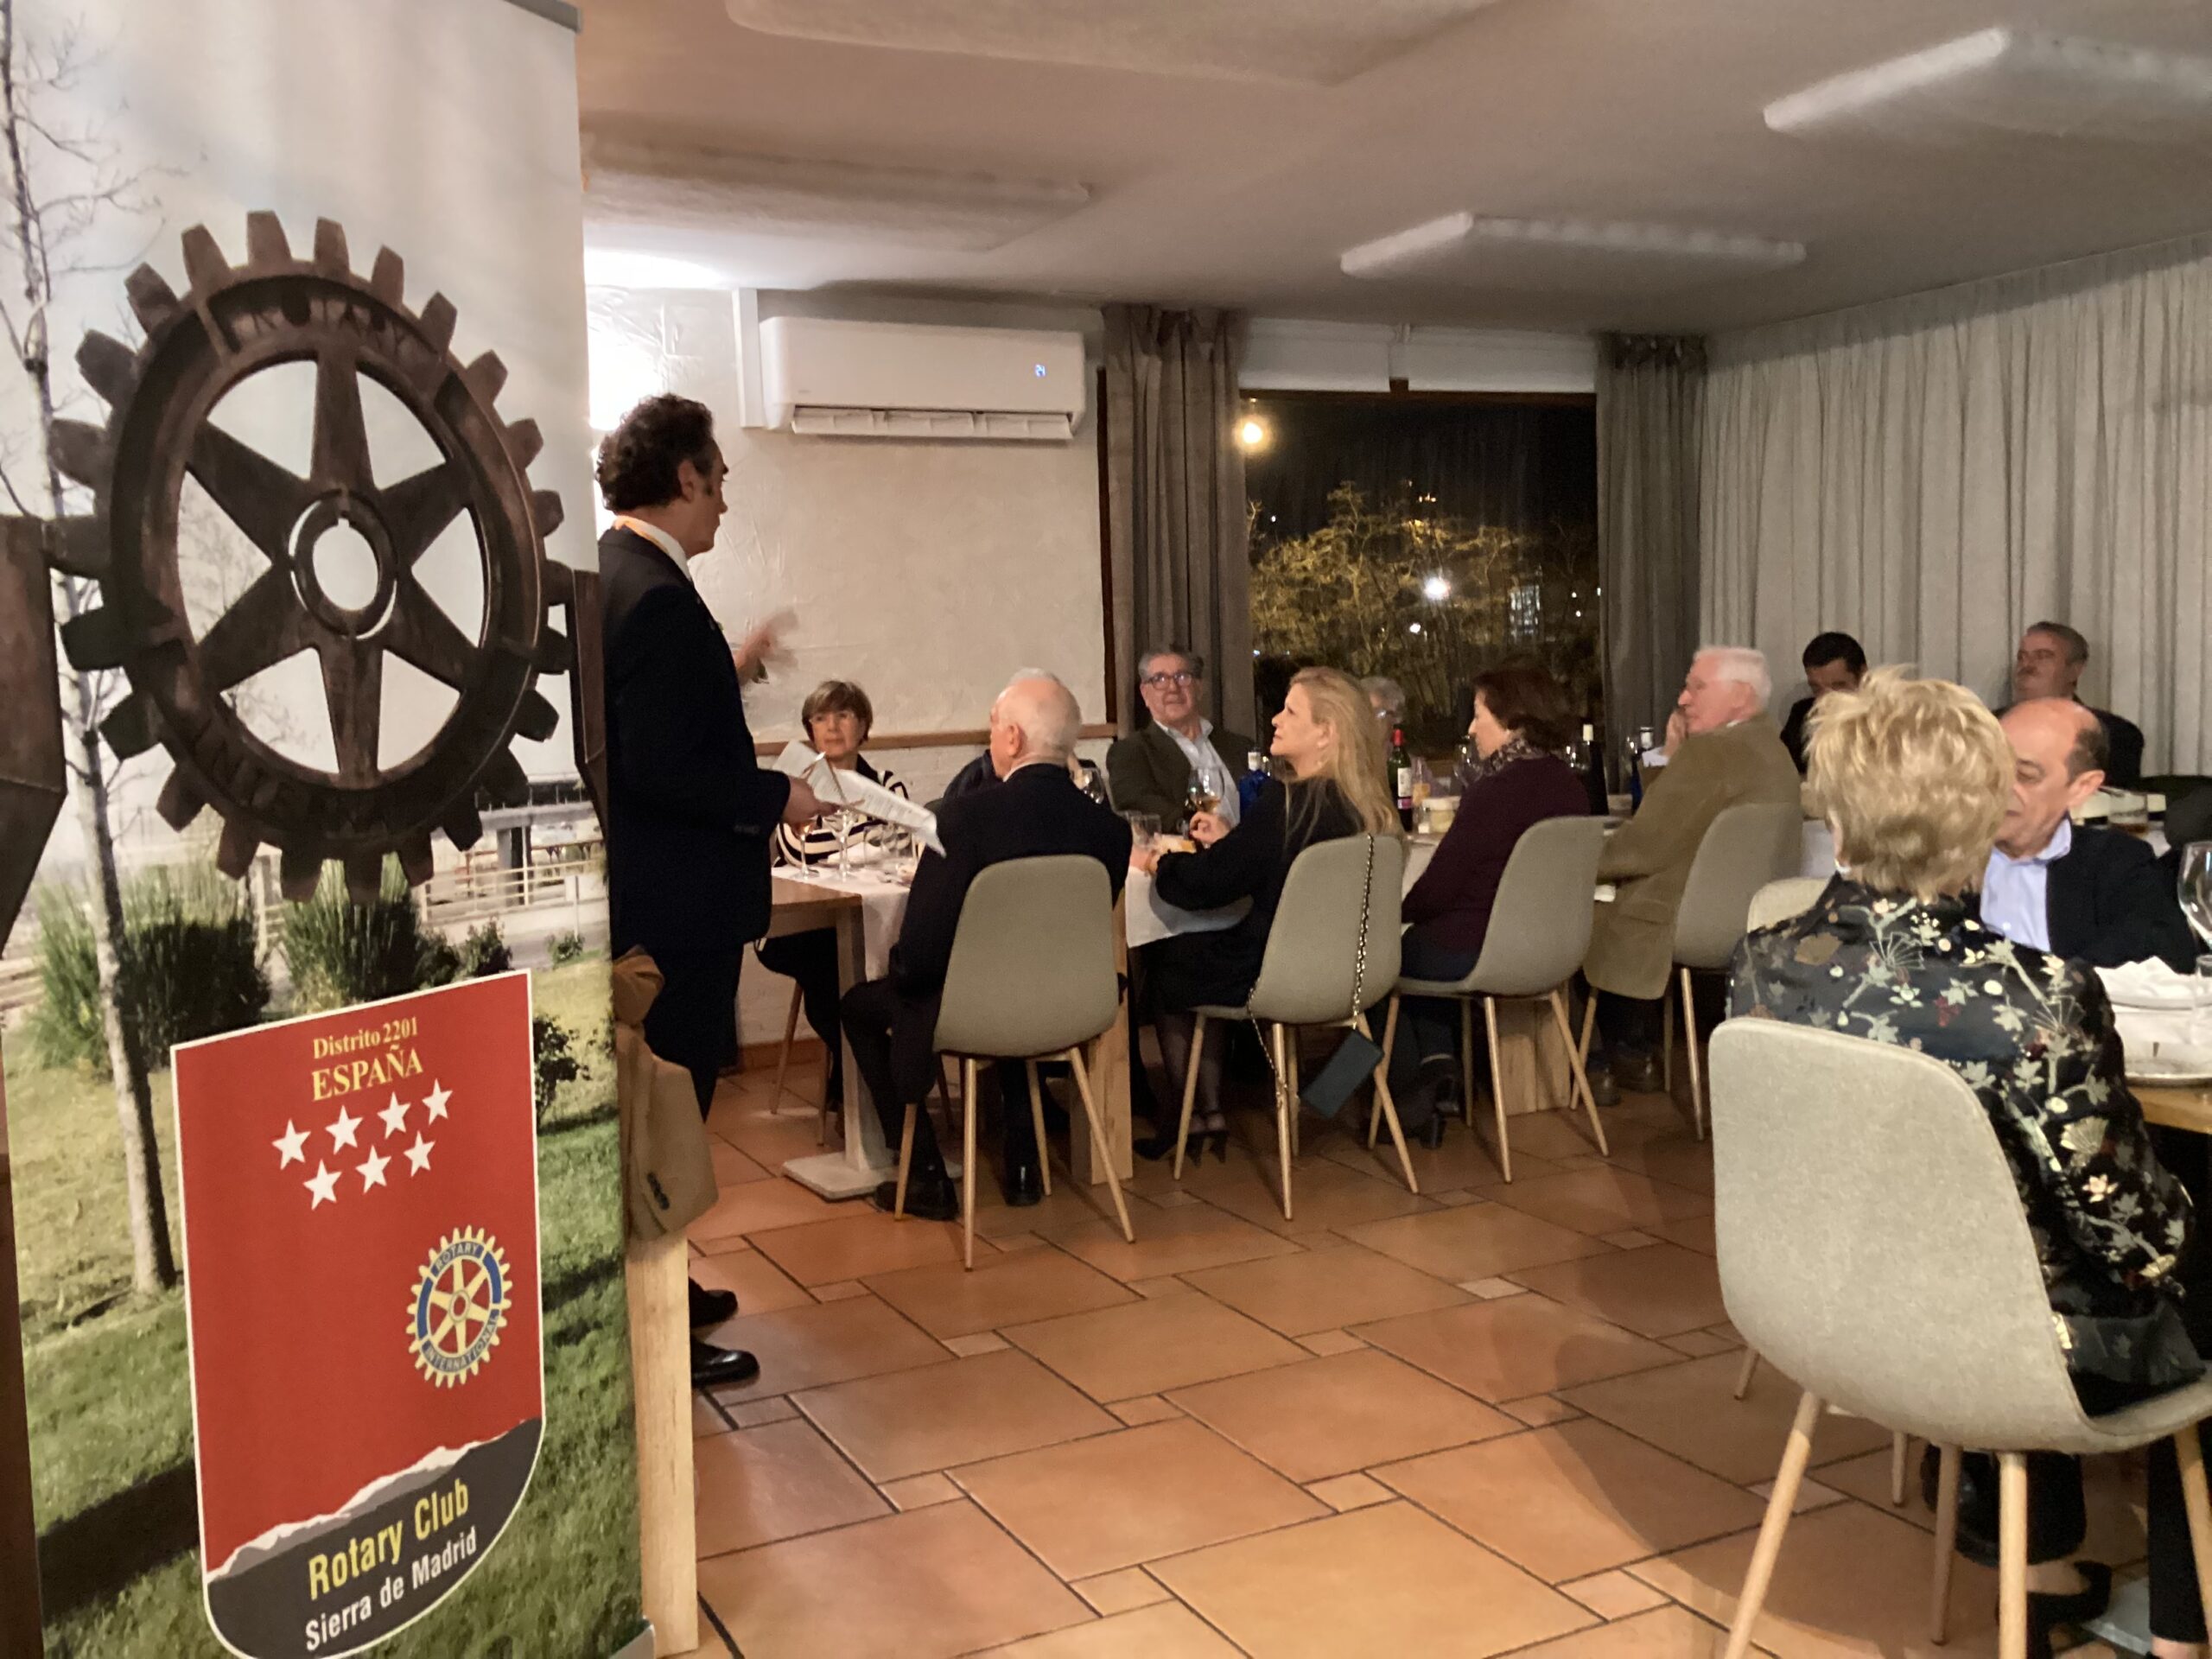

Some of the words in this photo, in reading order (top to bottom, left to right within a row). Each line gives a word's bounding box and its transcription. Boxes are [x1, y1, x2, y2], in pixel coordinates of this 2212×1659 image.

[313, 1028, 381, 1059] Distrito
[383, 1016, 417, 1044] 2201
[312, 1044, 423, 1102] ESPAÑA
[435, 1242, 478, 1271] ROTARY
[308, 1520, 404, 1600] Rotary
[414, 1478, 469, 1541] Club
[305, 1595, 372, 1651] Sierra
[379, 1576, 404, 1609] de
[411, 1525, 477, 1590] Madrid
